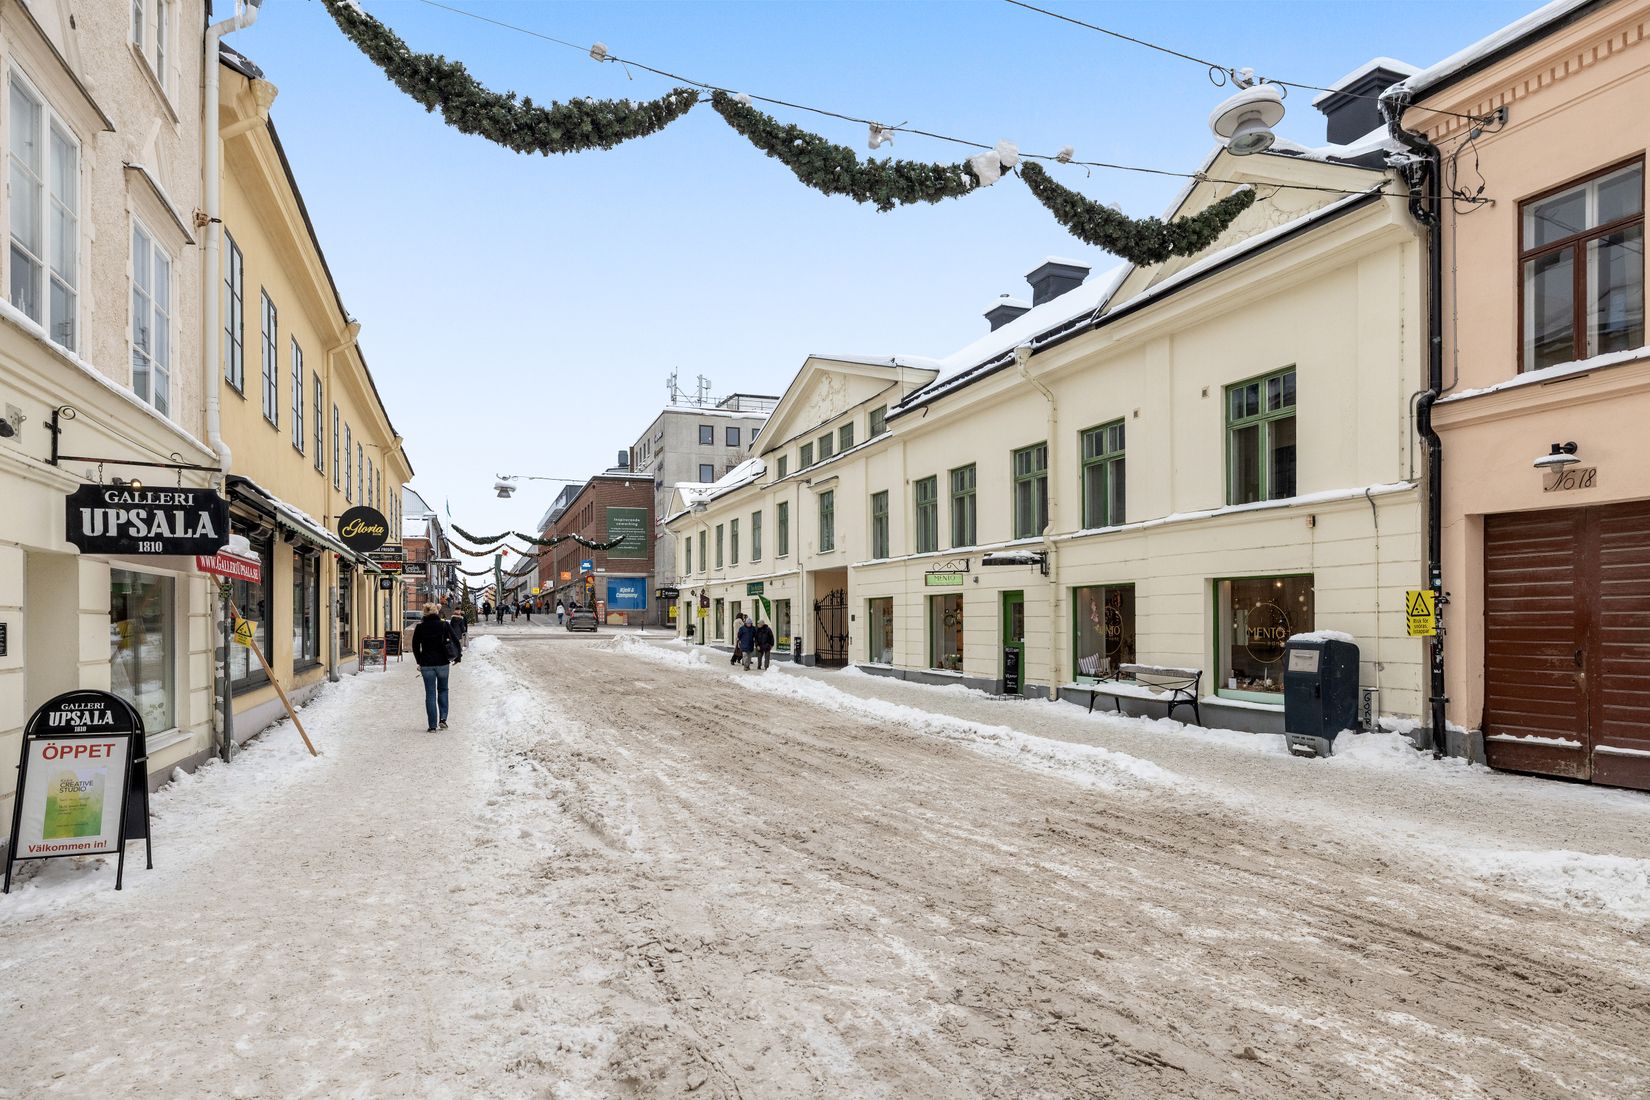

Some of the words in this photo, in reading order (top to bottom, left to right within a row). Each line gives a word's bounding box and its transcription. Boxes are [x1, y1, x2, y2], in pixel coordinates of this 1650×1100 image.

[1579, 468, 1597, 489] 18
[104, 490, 195, 506] GALLERI
[79, 507, 219, 539] UPSALA
[341, 518, 385, 538] Gloria
[138, 541, 163, 553] 1810
[1247, 626, 1286, 639] MENTO
[61, 702, 105, 710] GALLERI
[49, 710, 114, 727] UPSALA
[42, 742, 116, 761] ÖPPET
[60, 780, 94, 788] CREATIVE
[28, 841, 93, 853] Välkommen
[94, 840, 107, 849] in!
